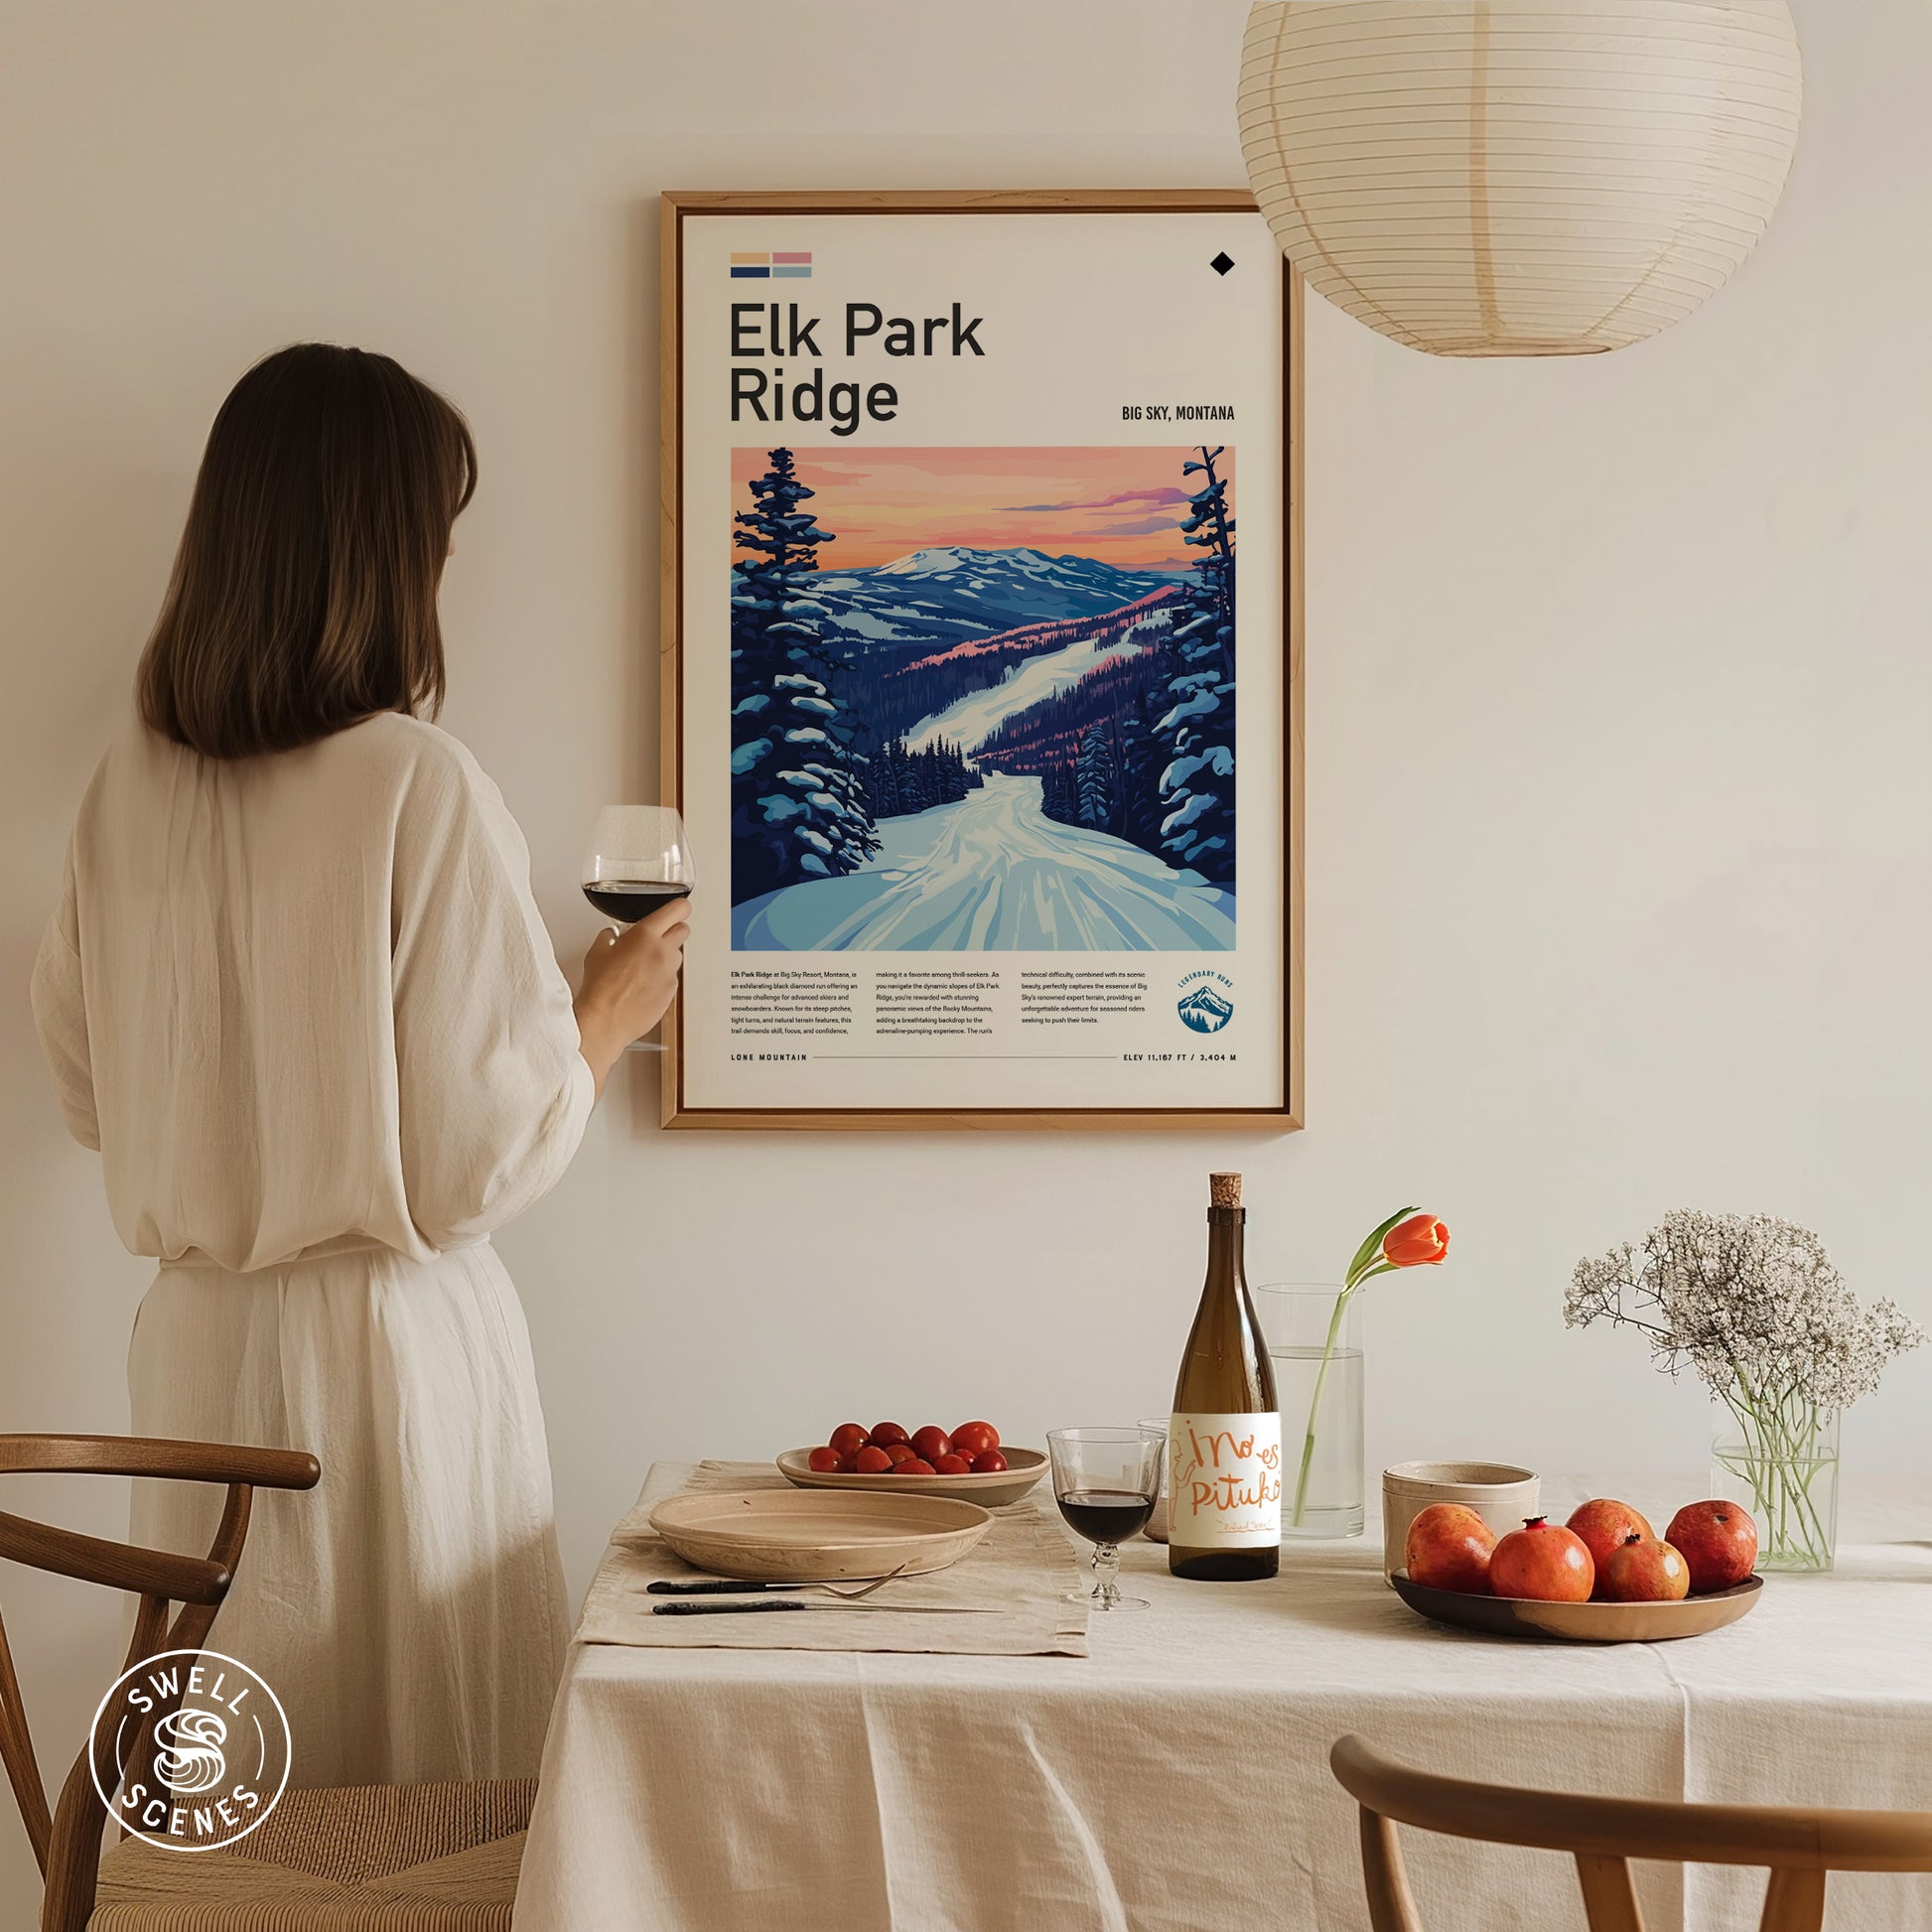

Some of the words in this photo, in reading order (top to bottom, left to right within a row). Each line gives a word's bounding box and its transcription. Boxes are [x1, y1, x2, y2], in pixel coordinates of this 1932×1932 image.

[731, 303, 823, 357] Elk
[846, 302, 986, 357] Park
[731, 367, 898, 437] Ridge
[1122, 406, 1142, 420] BIG
[1146, 405, 1172, 423] SKY,
[1175, 405, 1235, 421] MONTANA
[756, 971, 772, 980] Ridge
[876, 971, 897, 980] making
[1177, 970, 1215, 988] LEGENDARY
[1216, 973, 1233, 988] RUNS
[826, 982, 849, 991] offering
[1137, 982, 1148, 991] Big
[753, 994, 781, 1003] challenge
[876, 994, 895, 1003] Ridge,
[1106, 994, 1133, 1003] providing
[942, 1005, 961, 1014] Rocky
[1021, 1005, 1060, 1014] unforgettable
[1256, 1444, 1279, 1469] es
